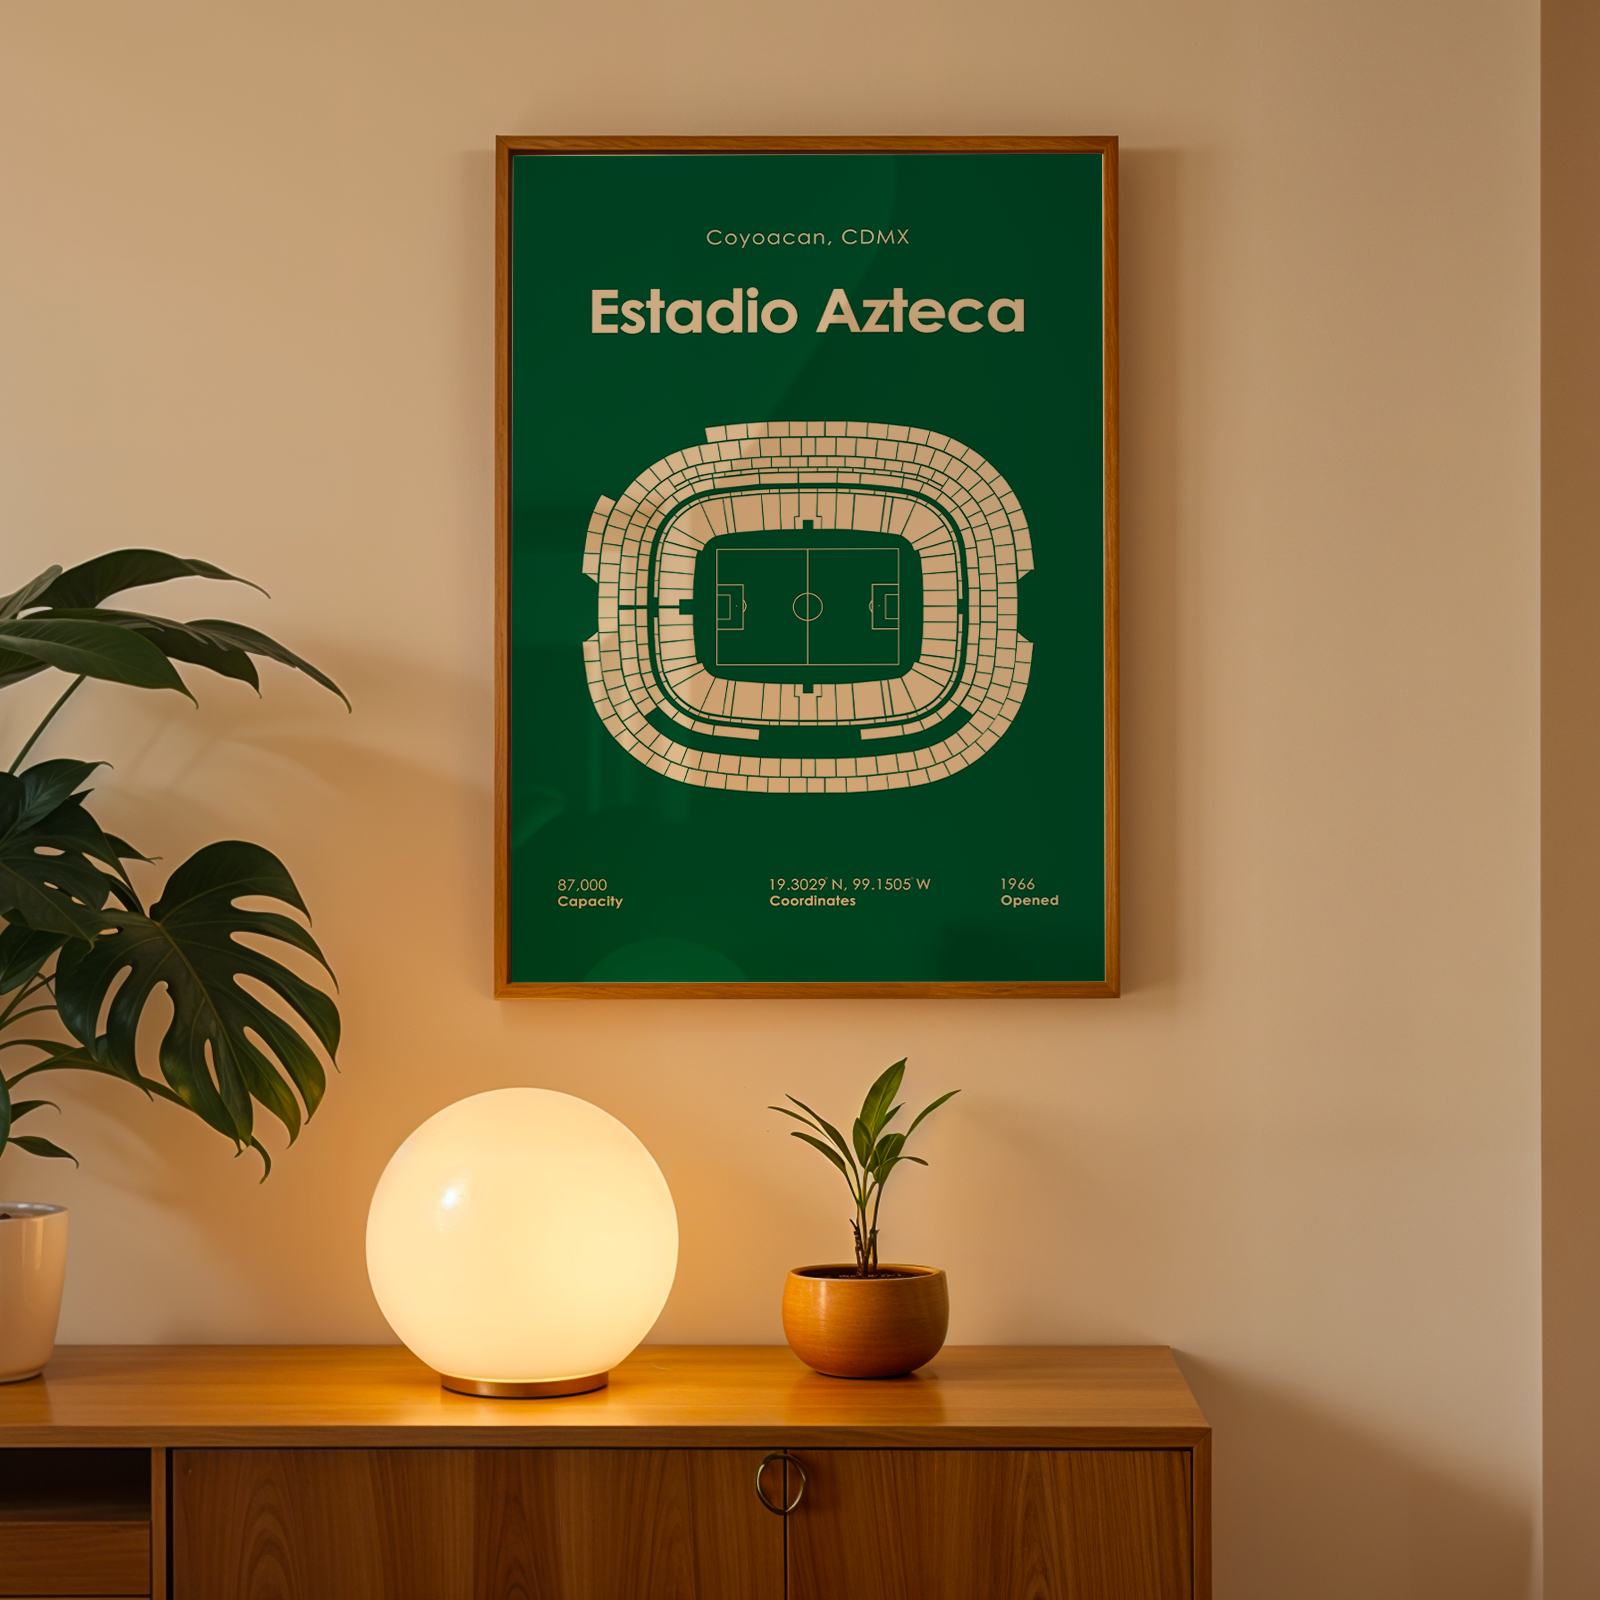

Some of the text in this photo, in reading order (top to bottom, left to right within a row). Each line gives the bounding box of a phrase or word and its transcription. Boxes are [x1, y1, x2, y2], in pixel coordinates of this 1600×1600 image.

[706, 228, 910, 249] Coyoacan, CDMX
[591, 287, 1025, 335] Estadio Azteca
[557, 878, 608, 892] 87,000
[831, 878, 848, 892] N,
[915, 878, 931, 891] W
[1000, 877, 1036, 891] 1966
[557, 895, 624, 910] Capacity
[769, 894, 857, 907] Coordinates
[1000, 894, 1059, 909] Opened
